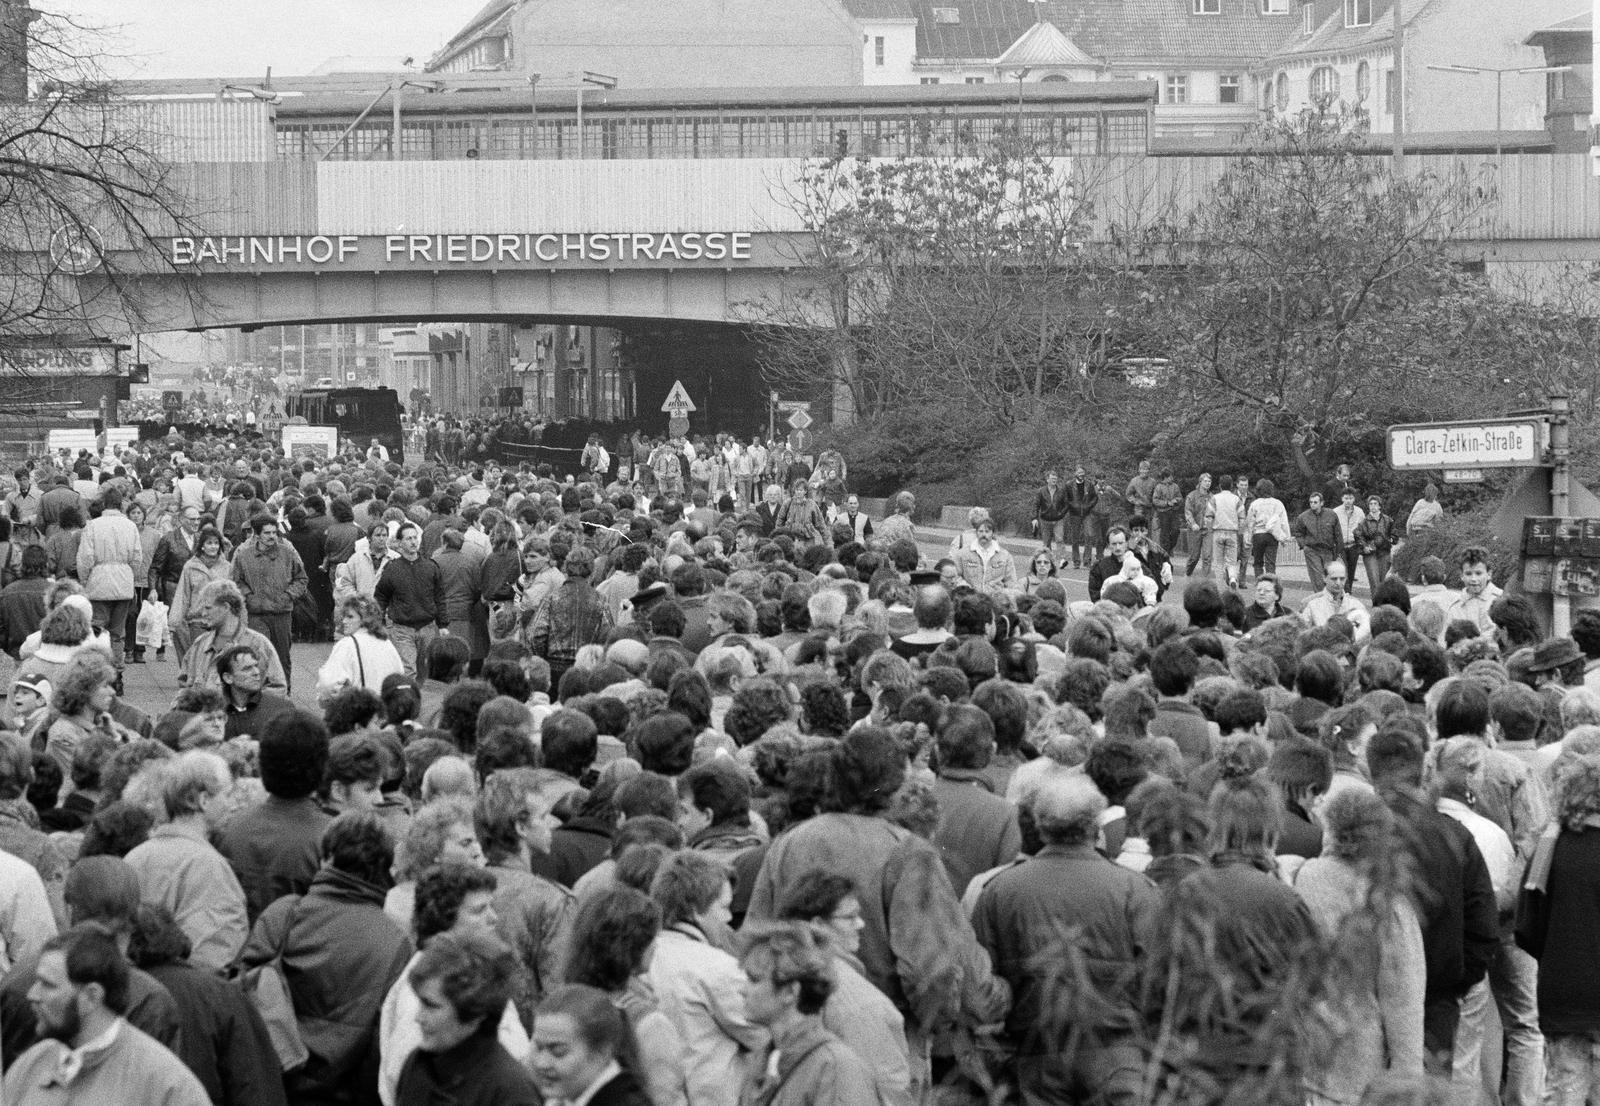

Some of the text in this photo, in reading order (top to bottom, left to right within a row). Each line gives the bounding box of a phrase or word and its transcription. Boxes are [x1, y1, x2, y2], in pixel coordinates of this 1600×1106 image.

[171, 232, 752, 265] BAHNHOF FRIEDRICHSTRASSE
[1405, 430, 1523, 455] Clara-Zetkin-Straße
